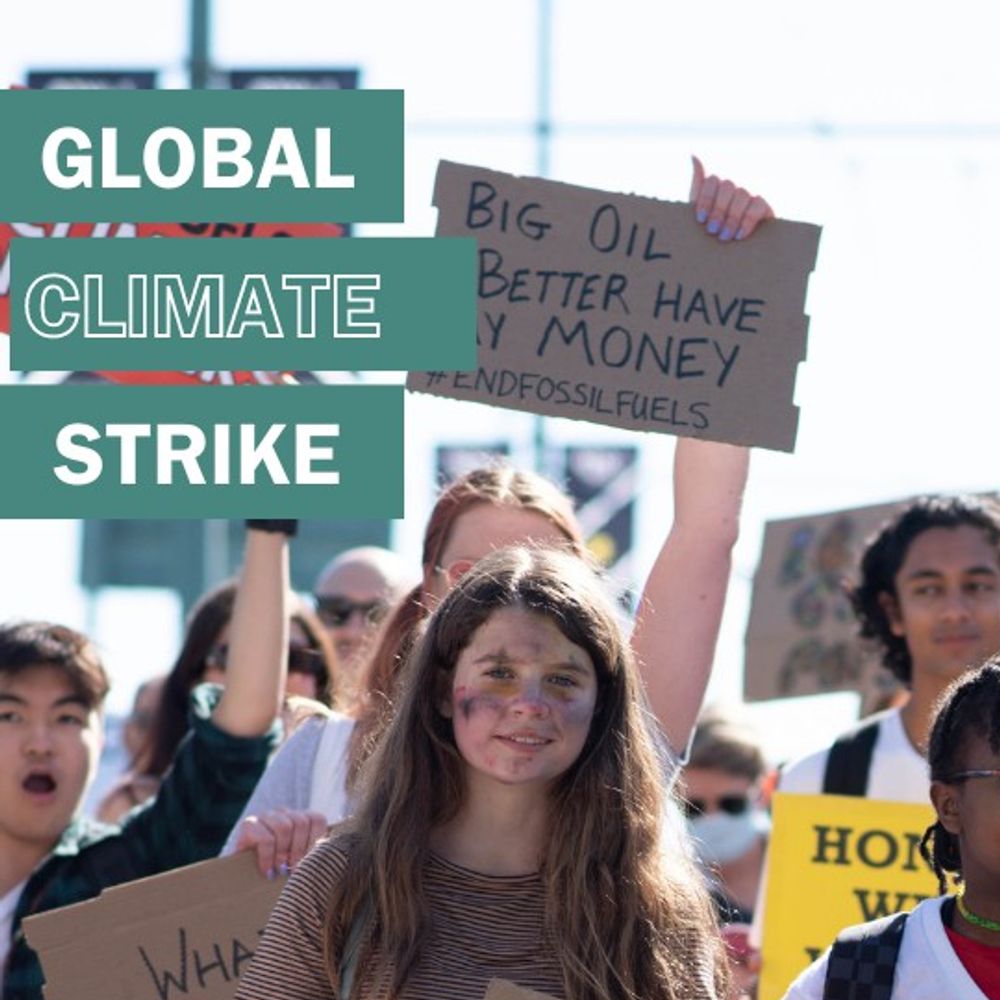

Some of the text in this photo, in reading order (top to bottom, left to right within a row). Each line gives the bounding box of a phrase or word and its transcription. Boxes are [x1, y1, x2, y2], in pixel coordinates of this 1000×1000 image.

[465, 181, 672, 262] BIG OIL
[478, 247, 765, 333] BETTER HAVE
[476, 313, 741, 388] Y MONEY
[426, 367, 711, 430] #ENDFOSSILFUELS
